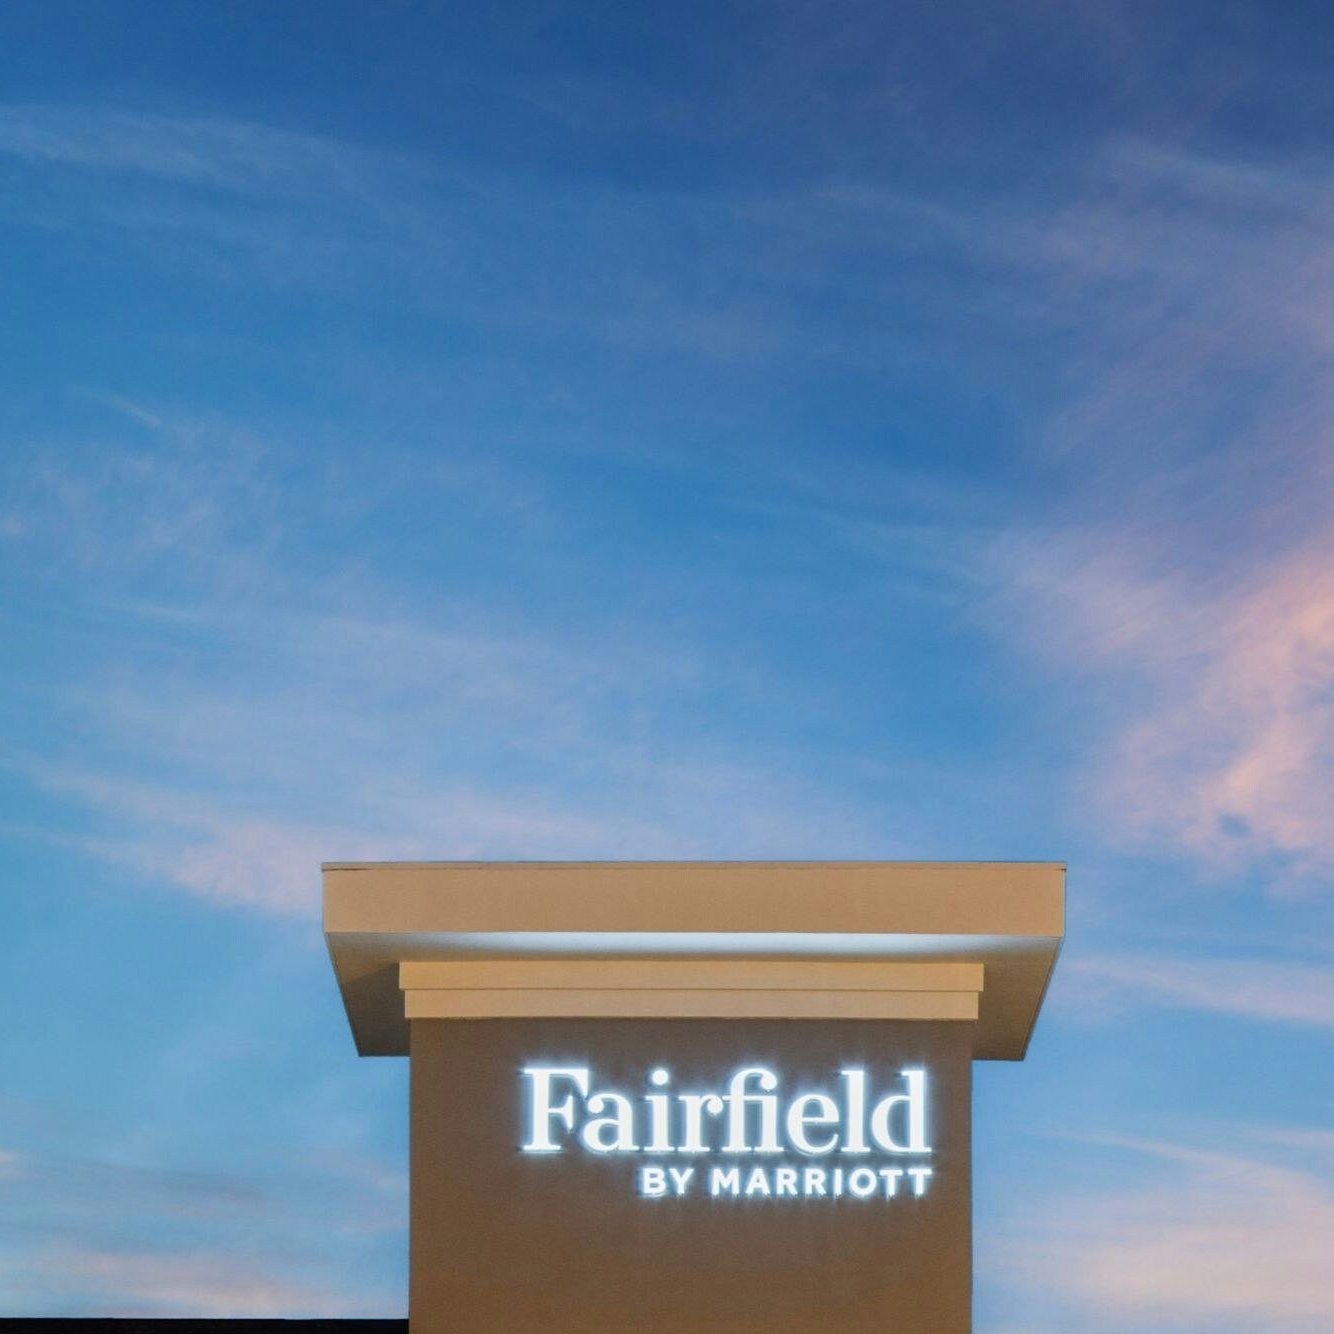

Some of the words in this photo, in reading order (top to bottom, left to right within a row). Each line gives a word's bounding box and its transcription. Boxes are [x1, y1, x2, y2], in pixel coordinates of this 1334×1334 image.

[521, 1067, 932, 1154] Fairfield
[642, 1167, 694, 1196] BY
[711, 1167, 932, 1197] MARRIOTT
